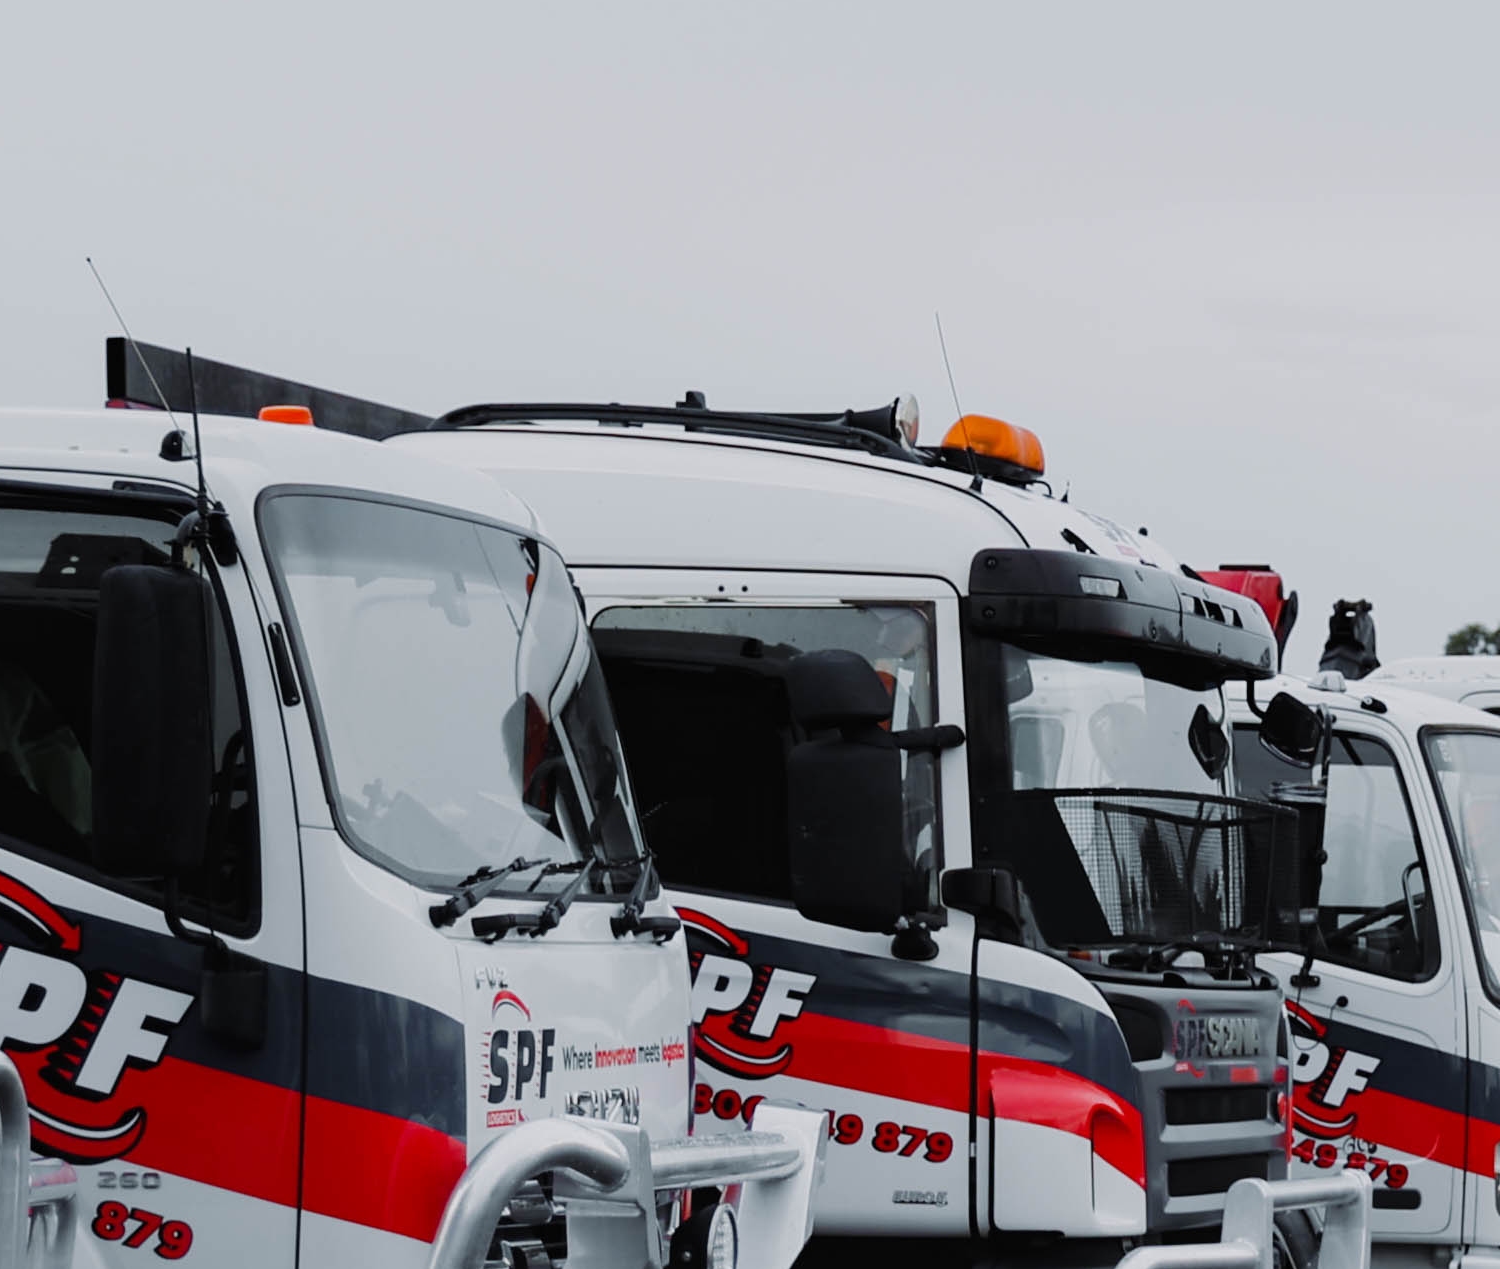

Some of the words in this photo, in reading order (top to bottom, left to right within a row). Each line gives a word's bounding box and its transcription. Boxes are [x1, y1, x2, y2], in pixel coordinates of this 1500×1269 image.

[487, 1028, 556, 1104] SPF
[561, 1045, 593, 1071] Where
[594, 1042, 637, 1069] innovation
[638, 1043, 661, 1064] meets
[871, 1121, 954, 1163] 879
[91, 1199, 194, 1261] 879
